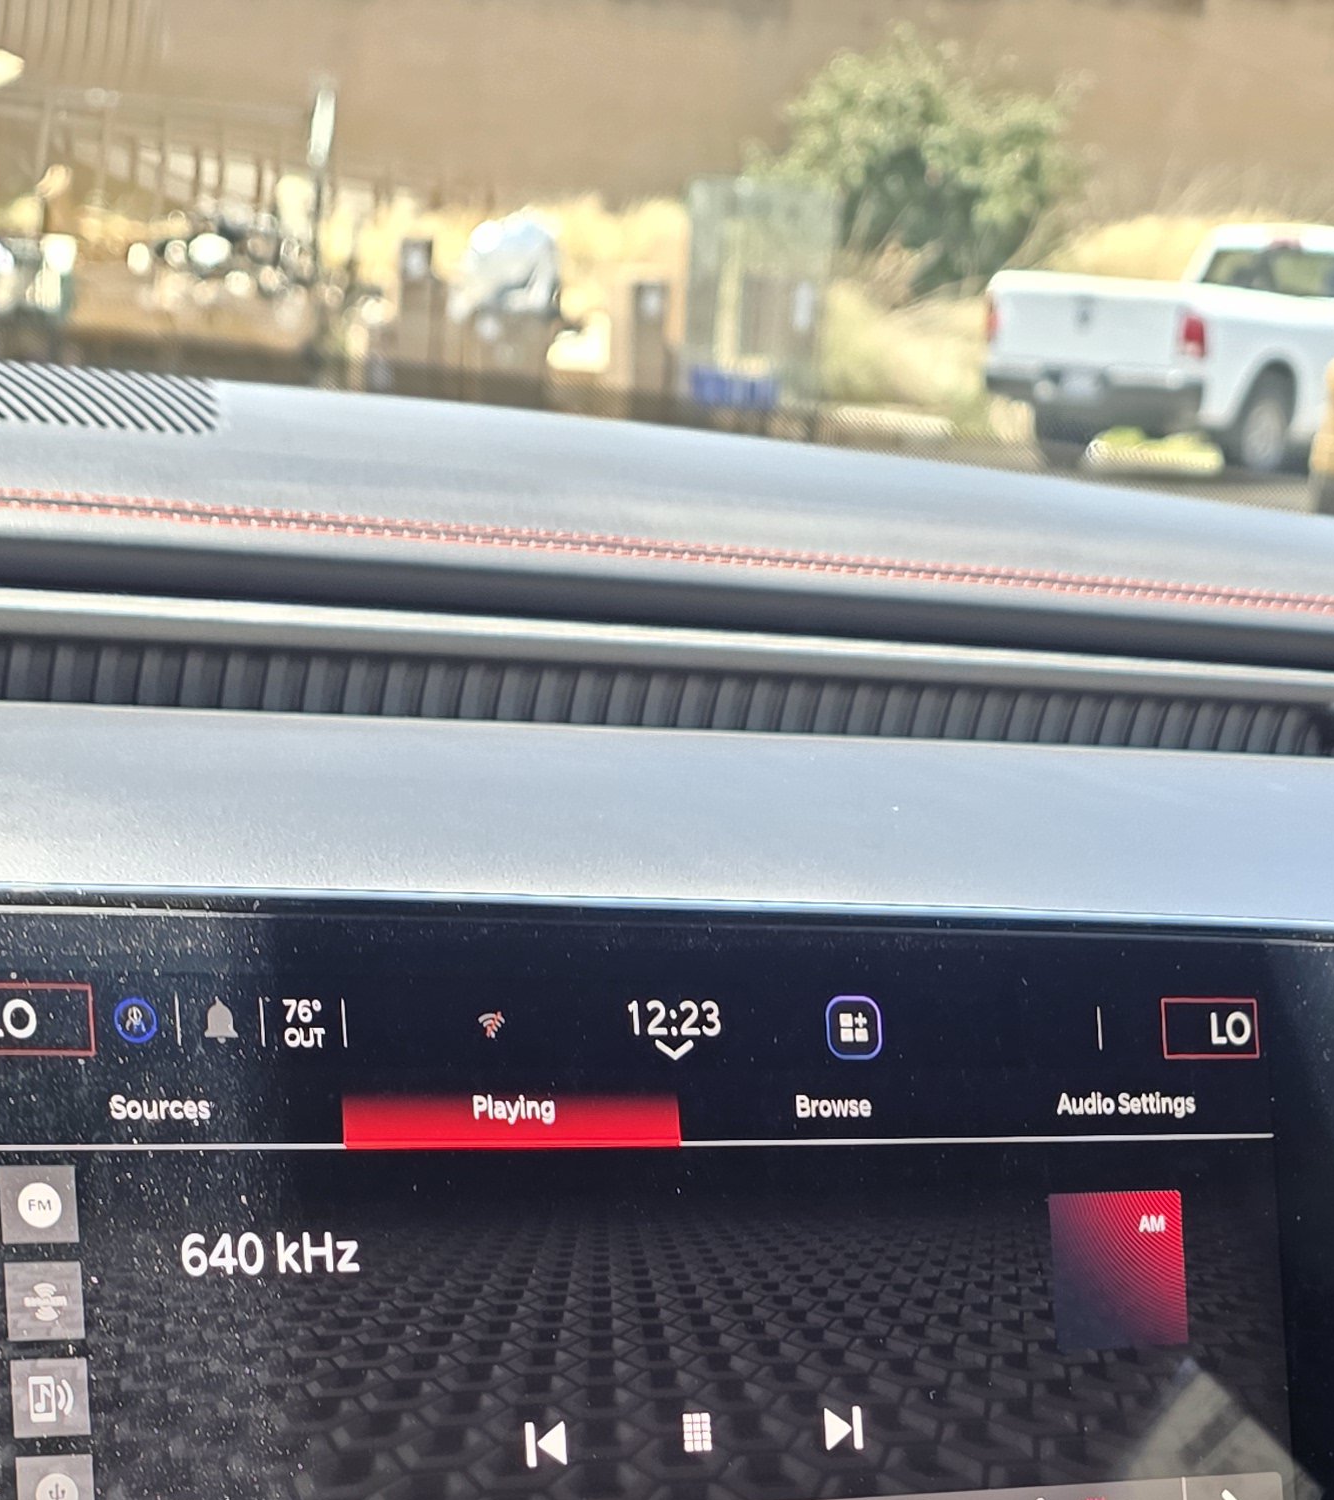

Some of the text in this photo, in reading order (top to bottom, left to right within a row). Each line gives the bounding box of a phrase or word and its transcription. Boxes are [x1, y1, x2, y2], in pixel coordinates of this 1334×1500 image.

[282, 999, 323, 1024] 76°
[628, 1000, 722, 1037] 12:23
[284, 1026, 326, 1049] OUT
[1209, 1012, 1252, 1046] LO
[110, 1095, 212, 1121] Sources
[472, 1095, 557, 1124] Playing
[795, 1094, 873, 1119] Browse
[1057, 1091, 1197, 1119] Audio Settings
[27, 1198, 53, 1213] FM
[1138, 1215, 1166, 1234] AM
[181, 1231, 361, 1277] 640 kHz
